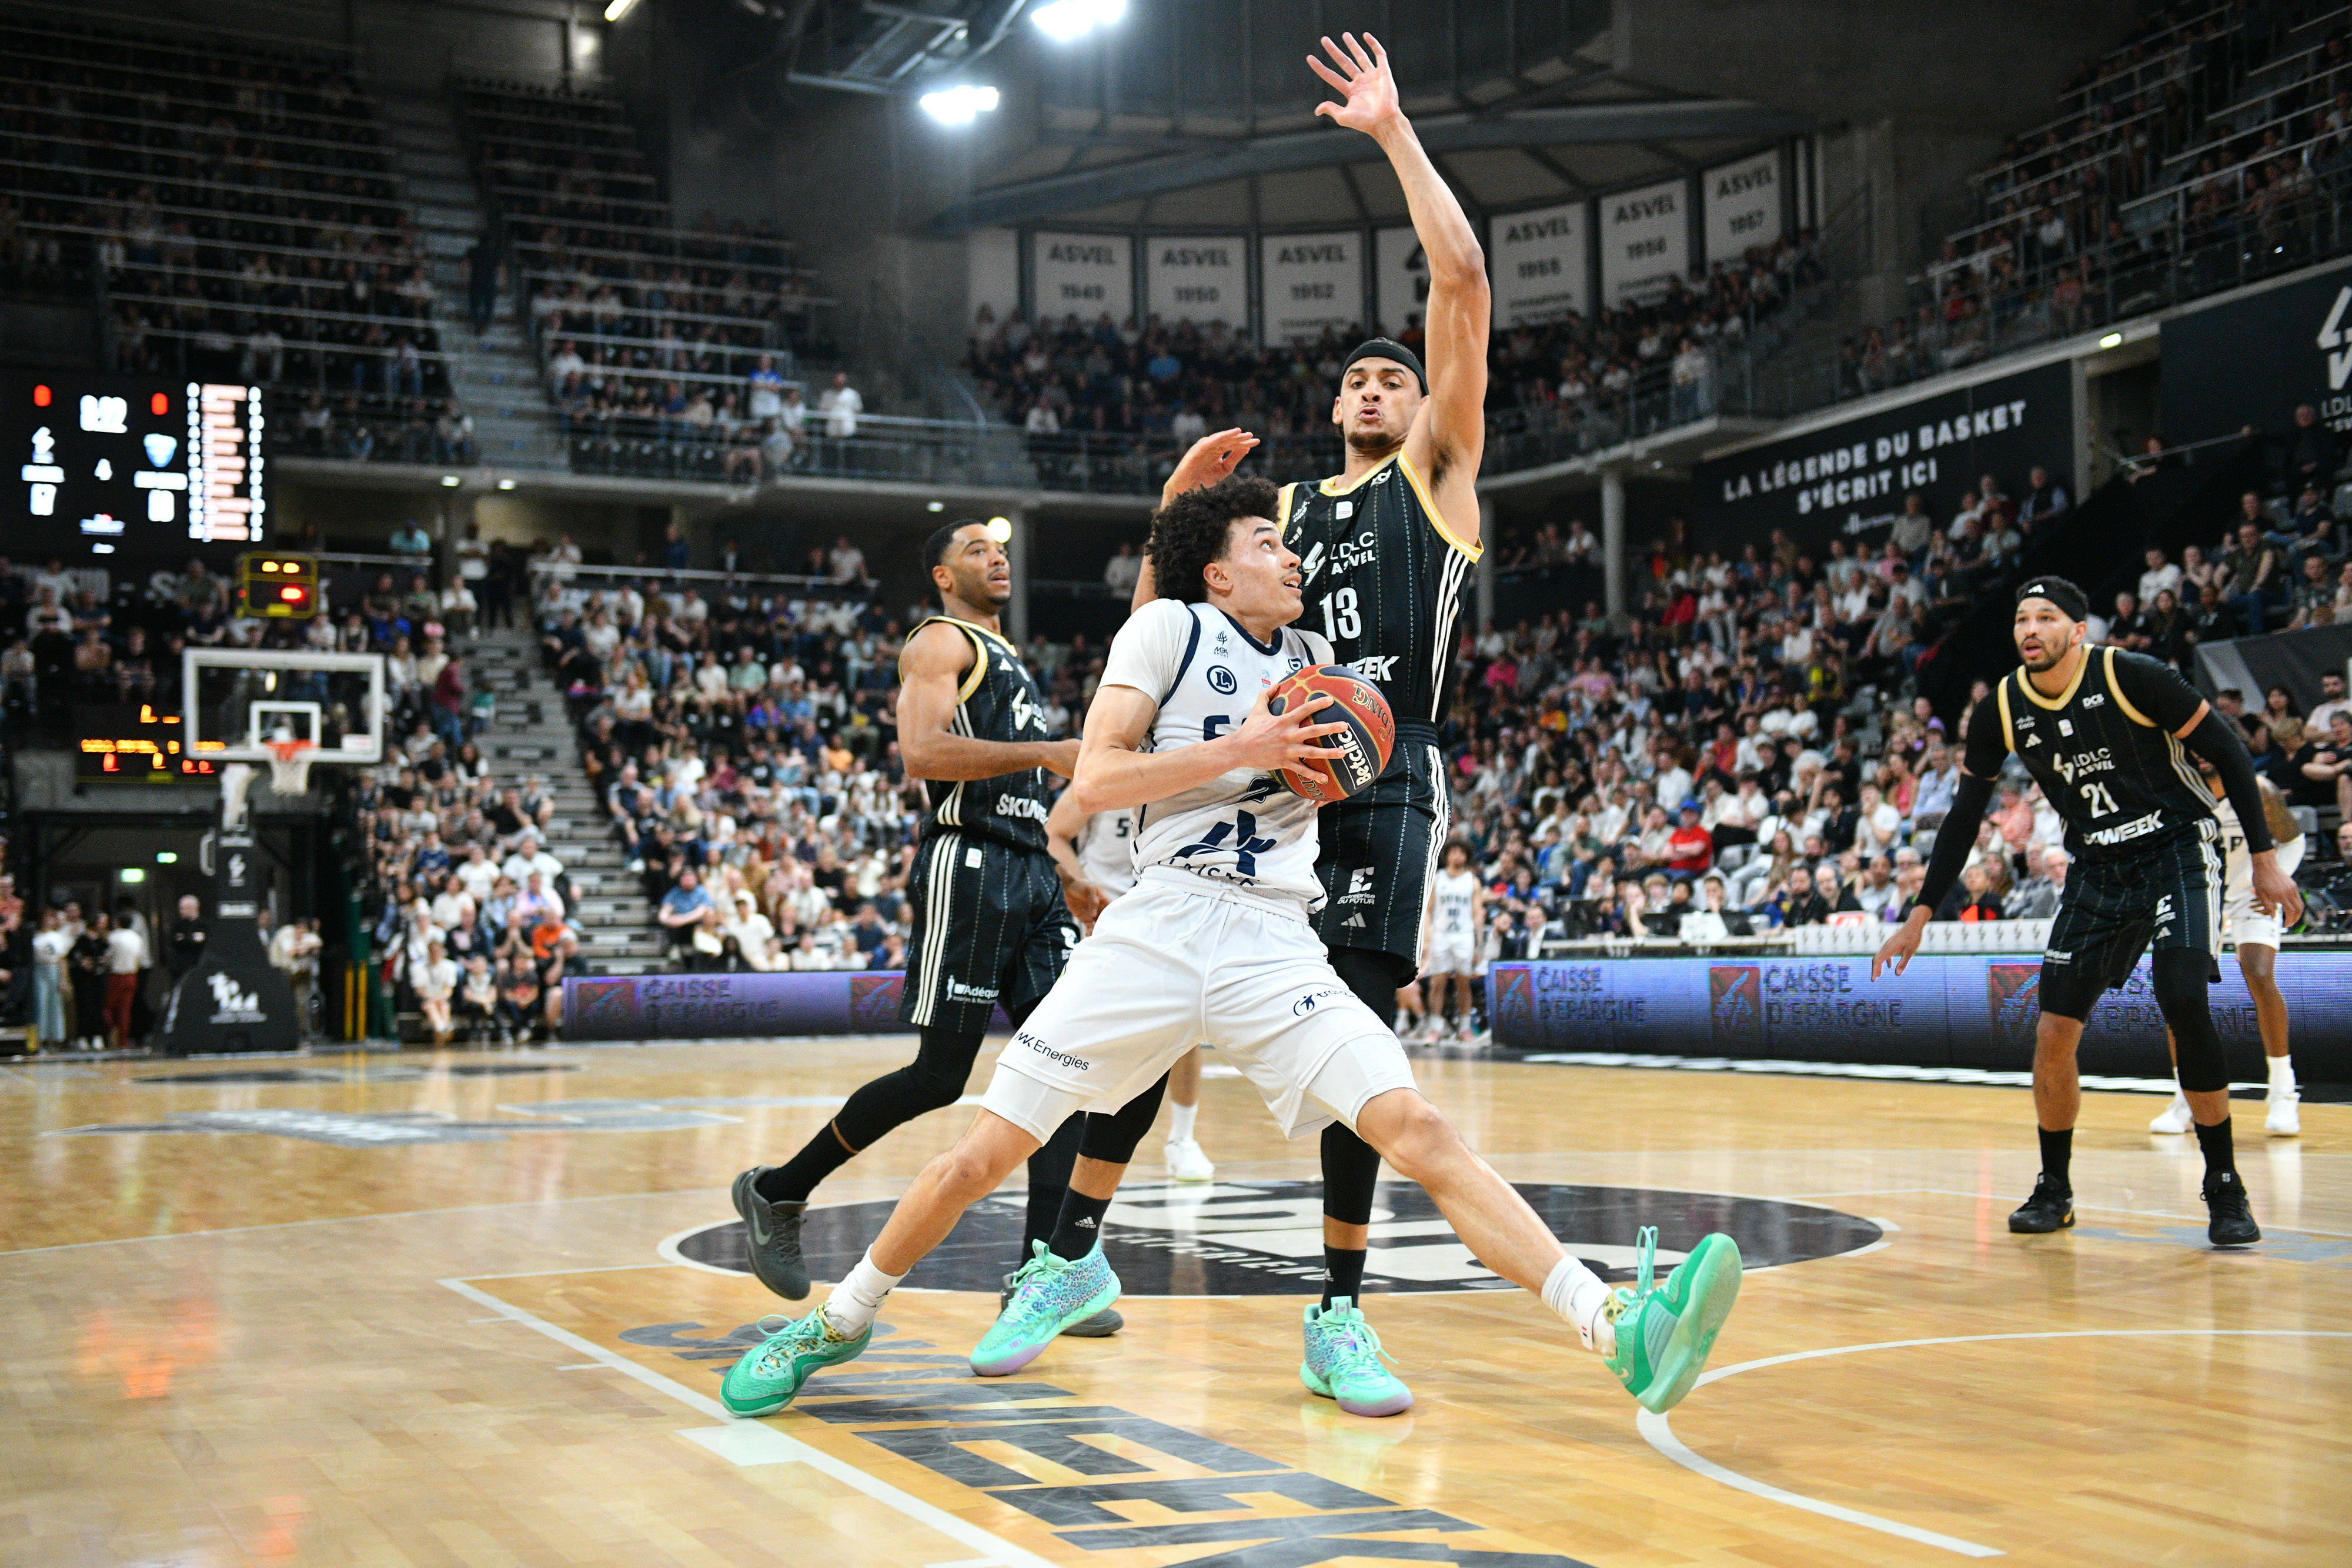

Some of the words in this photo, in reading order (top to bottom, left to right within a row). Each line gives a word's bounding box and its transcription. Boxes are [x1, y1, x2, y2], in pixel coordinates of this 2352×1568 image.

[1716, 162, 1775, 199] ASVEL
[1612, 193, 1678, 226] ASVEL
[1504, 216, 1572, 244] ASVEL
[1048, 245, 1116, 265] ASVEL
[1160, 247, 1231, 268] ASVEL
[1276, 244, 1348, 265] ASVEL
[1723, 474, 1752, 502] LA
[1759, 442, 1869, 493] LÉGENDE
[1875, 431, 1909, 463] DU
[1918, 400, 2027, 451] BASKET
[1798, 469, 1892, 514] S'ÉCRIT
[1902, 457, 1937, 489] ICI
[1329, 531, 1375, 560] LDLC
[1319, 587, 1362, 642] 13
[1339, 656, 1400, 681] EEK
[1337, 729, 1372, 786] Betclic
[2073, 747, 2112, 768] LDLC
[2077, 758, 2116, 778] ASVEL
[2080, 781, 2120, 819] 21
[1338, 892, 1376, 901] entreprise
[643, 978, 731, 1000] CAISSE
[1537, 966, 1603, 992] CAISSE
[1763, 964, 1853, 994] CAISSE
[1033, 1039, 1090, 1071] Energies
